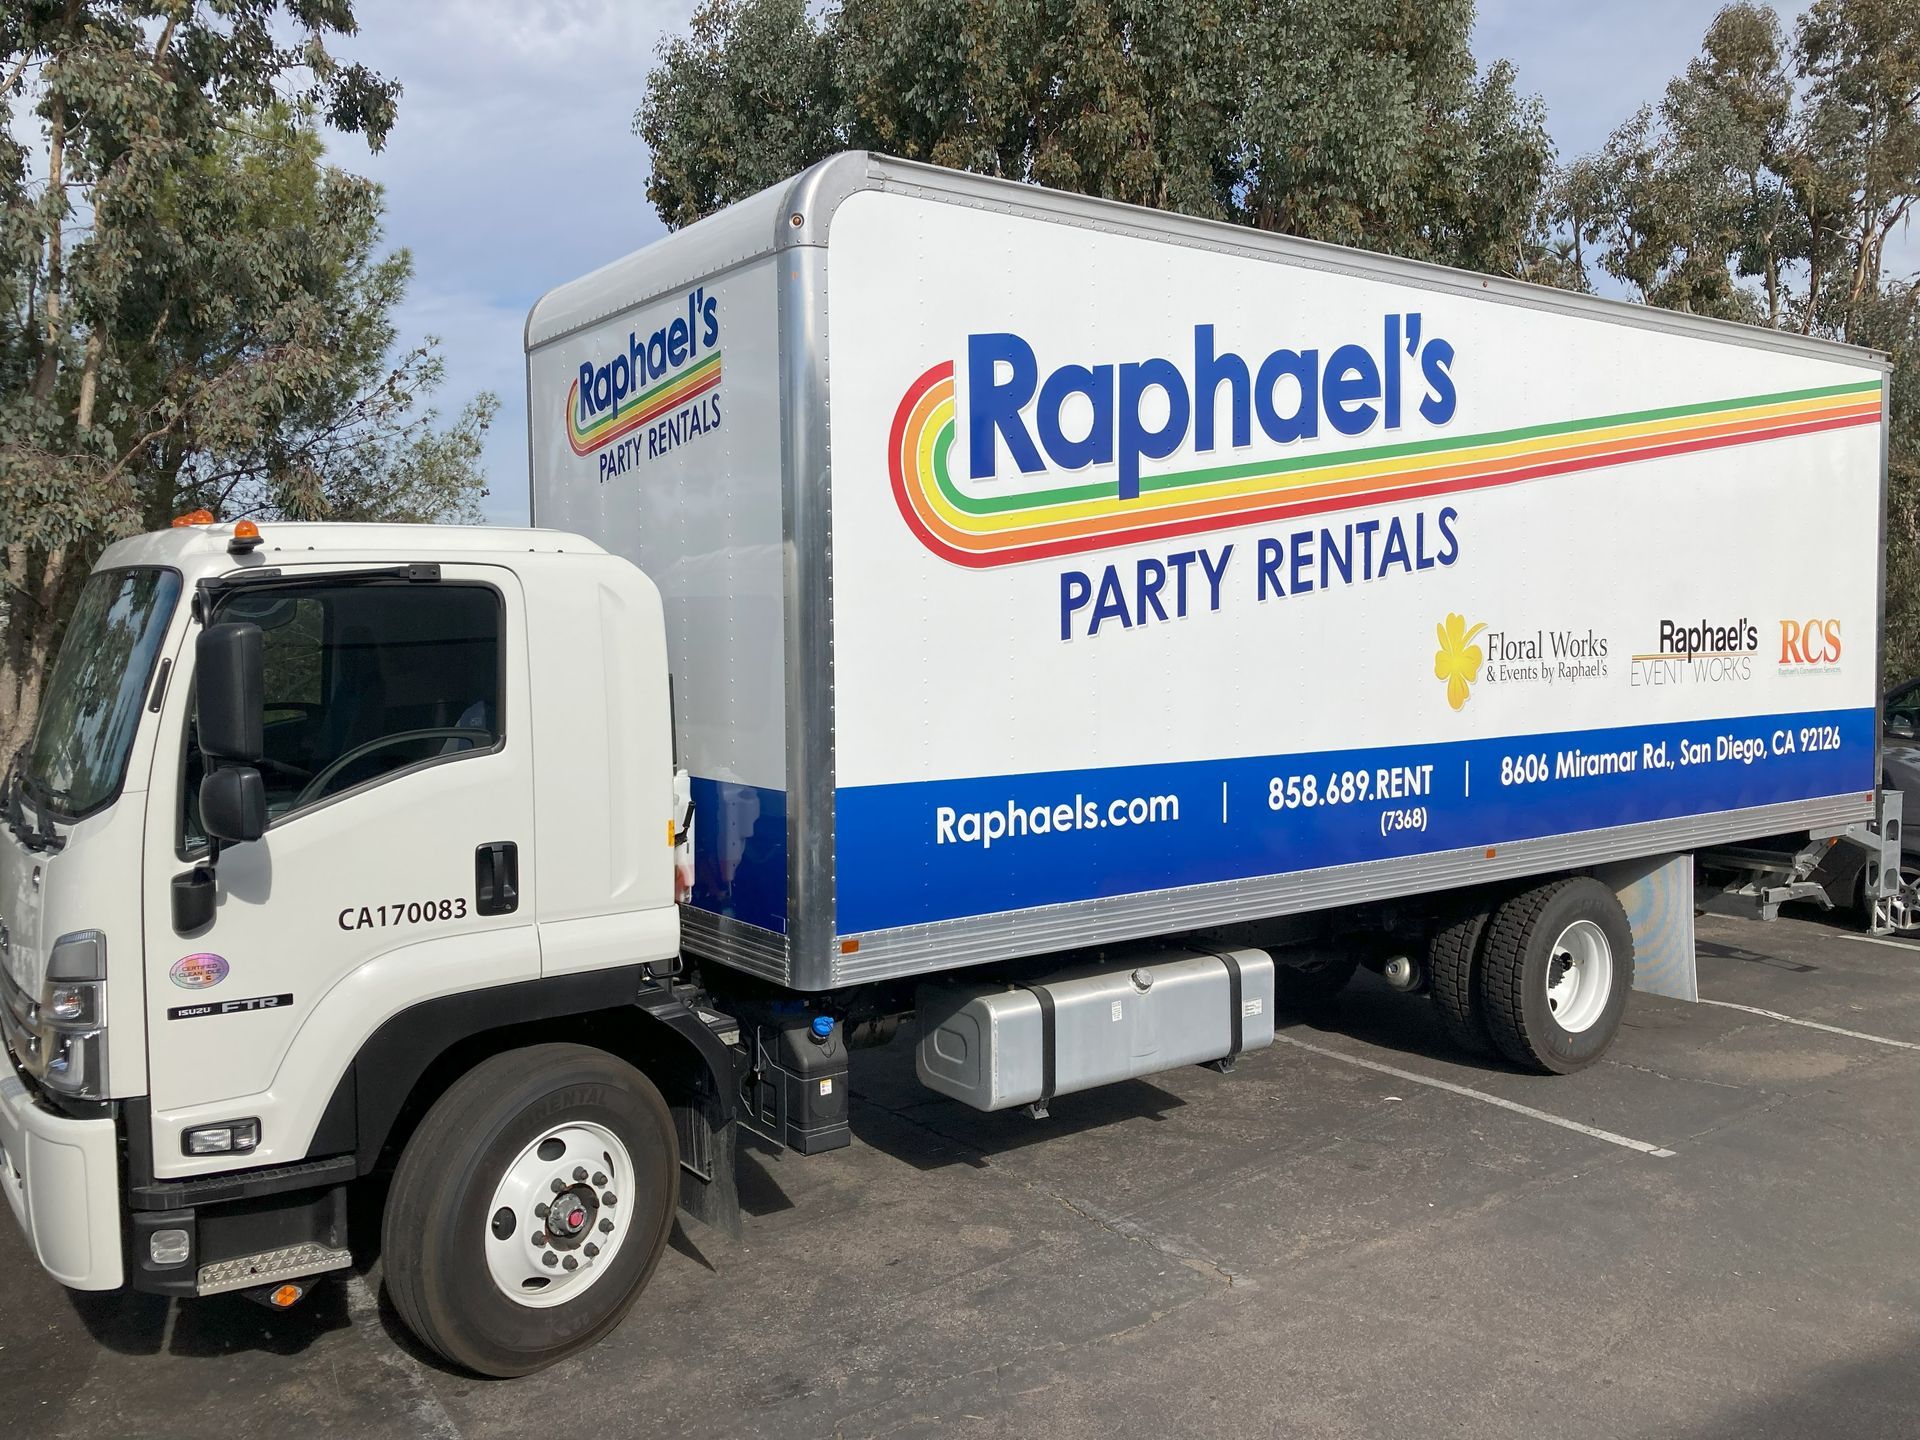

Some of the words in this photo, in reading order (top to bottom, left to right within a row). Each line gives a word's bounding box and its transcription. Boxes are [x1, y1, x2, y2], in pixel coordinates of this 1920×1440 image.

[580, 287, 719, 422] Raphael's
[968, 313, 1457, 499] Raphael's
[600, 434, 642, 484] PARTY
[649, 393, 720, 459] RENTALS
[1060, 545, 1233, 640] PARTY
[1258, 507, 1458, 600] RENTALS
[1488, 630, 1543, 661] Floral
[1549, 629, 1607, 660] Works
[1660, 618, 1758, 663] Raphael's
[1779, 619, 1842, 664] RCS
[1486, 666, 1496, 682] &
[1500, 664, 1538, 682] Events
[1541, 662, 1555, 683] by
[1558, 660, 1607, 682] Raphael's
[1631, 659, 1686, 687] EVENT
[1694, 657, 1751, 683] WORKS
[1501, 753, 1549, 786] 8606
[1555, 748, 1638, 780] Miramar
[1643, 741, 1675, 771] Rd.,
[1680, 739, 1711, 765] San
[1716, 733, 1768, 764] Diego,
[1772, 730, 1795, 756] CA
[1800, 725, 1841, 753] 92126
[1268, 764, 1433, 812] 858.689.RENT
[936, 794, 1179, 848] Raphaels.com
[1380, 807, 1428, 836] (7368)
[338, 898, 467, 931] CA170083
[182, 963, 217, 972] CERTIFIED
[178, 1006, 211, 1017] ISUZU
[221, 996, 279, 1013] FTR
